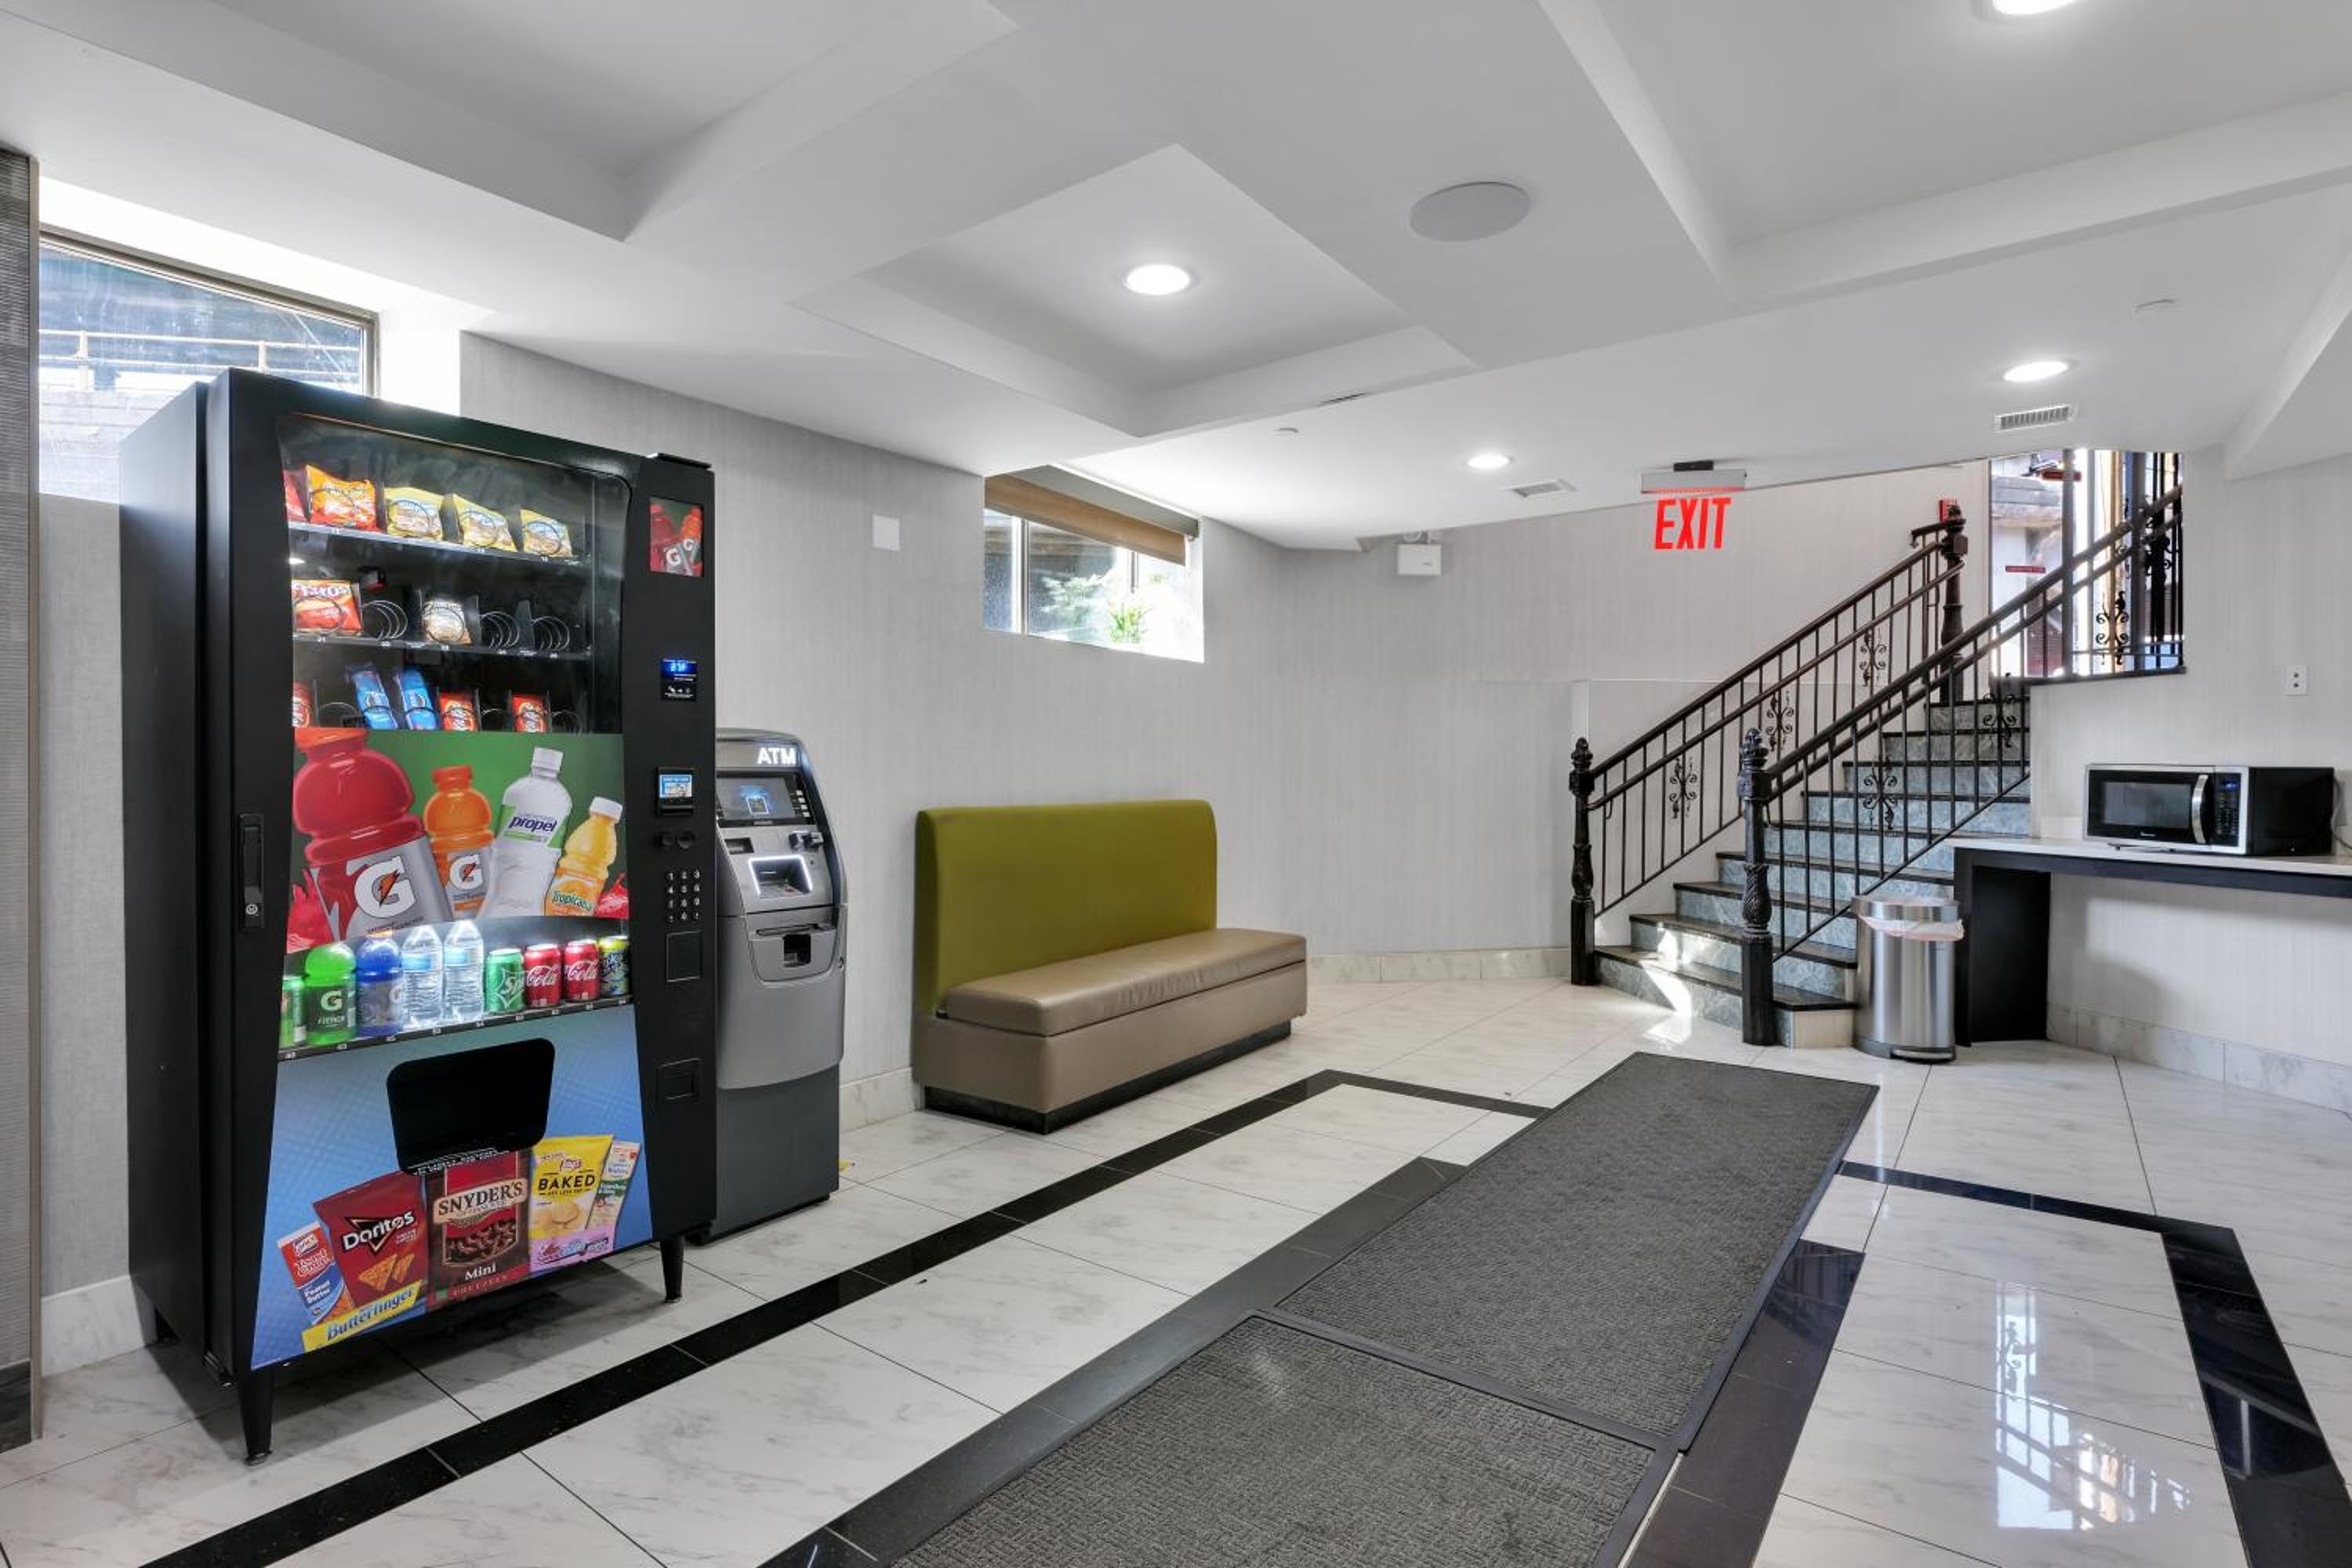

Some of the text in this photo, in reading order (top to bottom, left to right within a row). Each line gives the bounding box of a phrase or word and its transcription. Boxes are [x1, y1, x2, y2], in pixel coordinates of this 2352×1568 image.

[1654, 497, 1731, 550] EXIT
[757, 747, 797, 765] ATM
[509, 816, 557, 833] propel
[449, 854, 484, 890] G
[354, 855, 416, 918] G
[551, 890, 593, 910] Tropicana
[321, 990, 343, 1011] G
[538, 1174, 596, 1191] BAKED
[438, 1181, 523, 1216] SNYDER'S
[343, 1211, 416, 1250] Doritos
[465, 1261, 497, 1280] Mini
